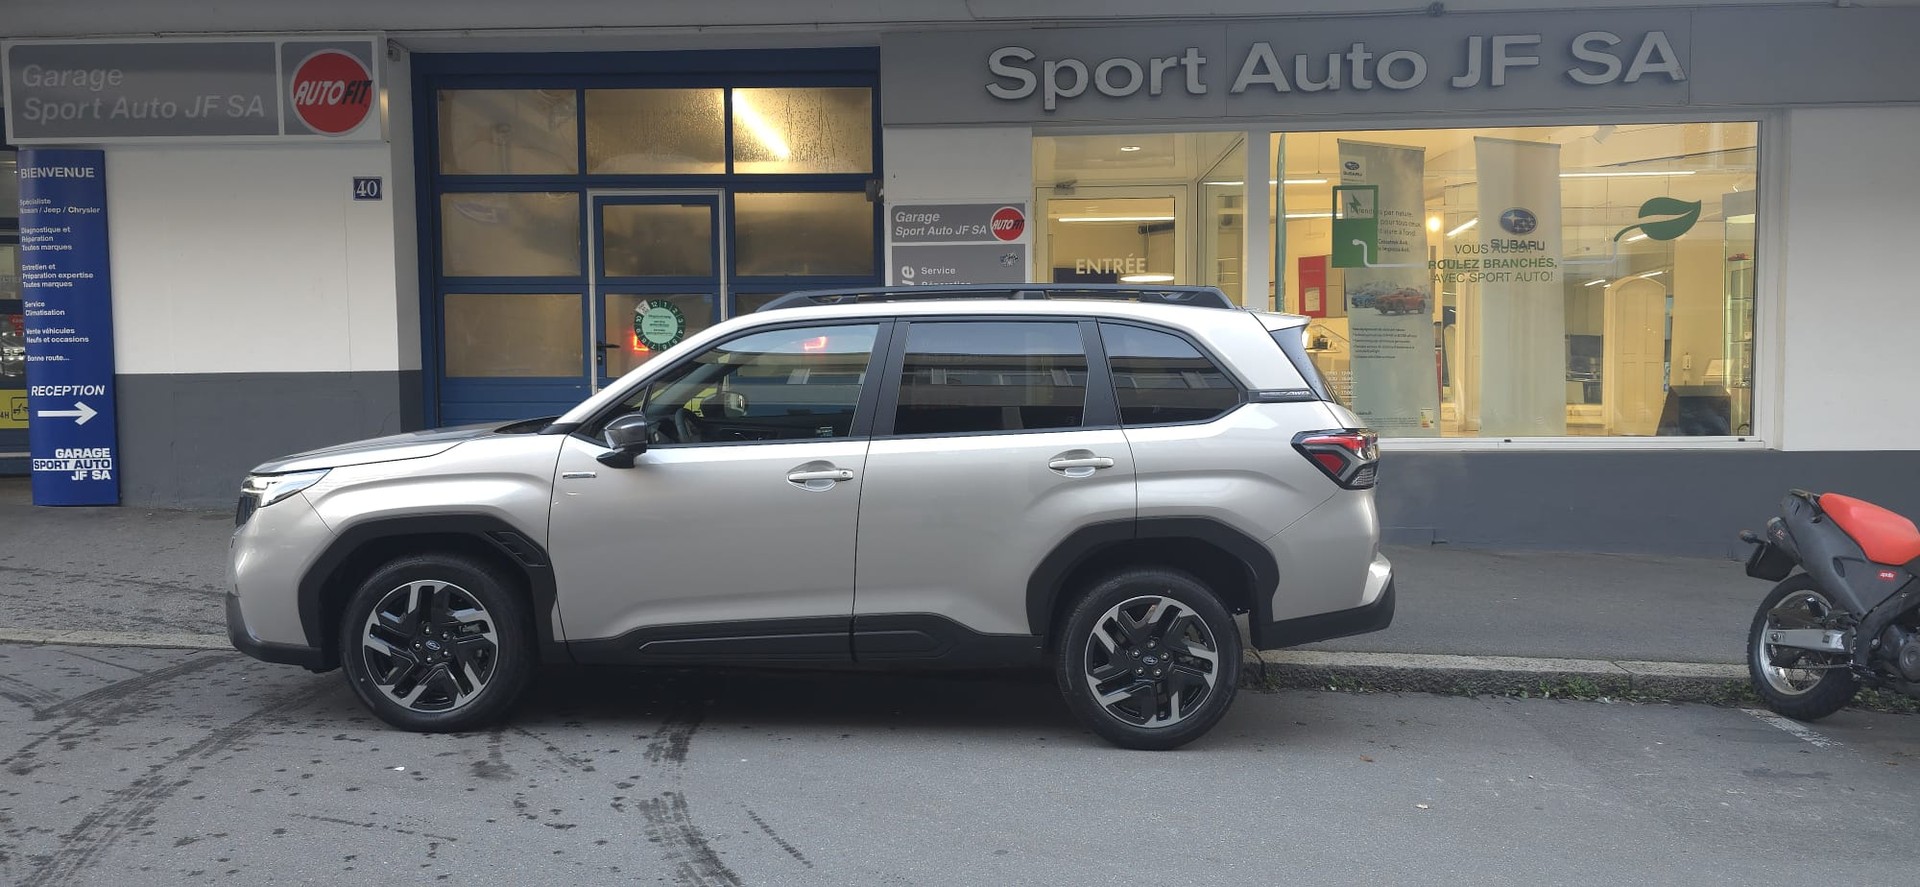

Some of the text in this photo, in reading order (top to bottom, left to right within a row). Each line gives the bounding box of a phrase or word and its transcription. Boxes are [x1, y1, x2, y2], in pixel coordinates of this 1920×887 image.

[985, 31, 1688, 111] Sport Auto JF SA
[22, 64, 124, 91] Garage
[294, 79, 373, 106] AUTOFIT
[22, 95, 266, 125] Sport Auto JF SA
[20, 167, 95, 179] BIENVENUE
[356, 180, 378, 197] 40
[68, 206, 101, 215] Chrysler
[895, 212, 940, 224] Garage
[21, 227, 61, 235] Diagnostique
[895, 225, 987, 238] Sport Auto JF SA
[21, 235, 54, 243] Réparation
[1490, 239, 1545, 251] SUBARU
[1454, 244, 1489, 254] VOUS
[1075, 253, 1147, 275] ENTRÉE
[1428, 255, 1558, 270] ROULEZ BRANCHÉS,
[22, 272, 57, 280] Préparation
[58, 271, 94, 280] expertise
[920, 267, 956, 275] Service
[1433, 271, 1554, 283] AVEC SPORT AUTO!
[25, 309, 65, 317] Climatisation
[42, 327, 75, 335] véhicules
[45, 354, 70, 362] route...
[31, 385, 105, 397] RECEPTION
[55, 448, 110, 459] GARAGE
[34, 459, 110, 470] SPORT AUTO
[71, 470, 111, 481] JF SA
